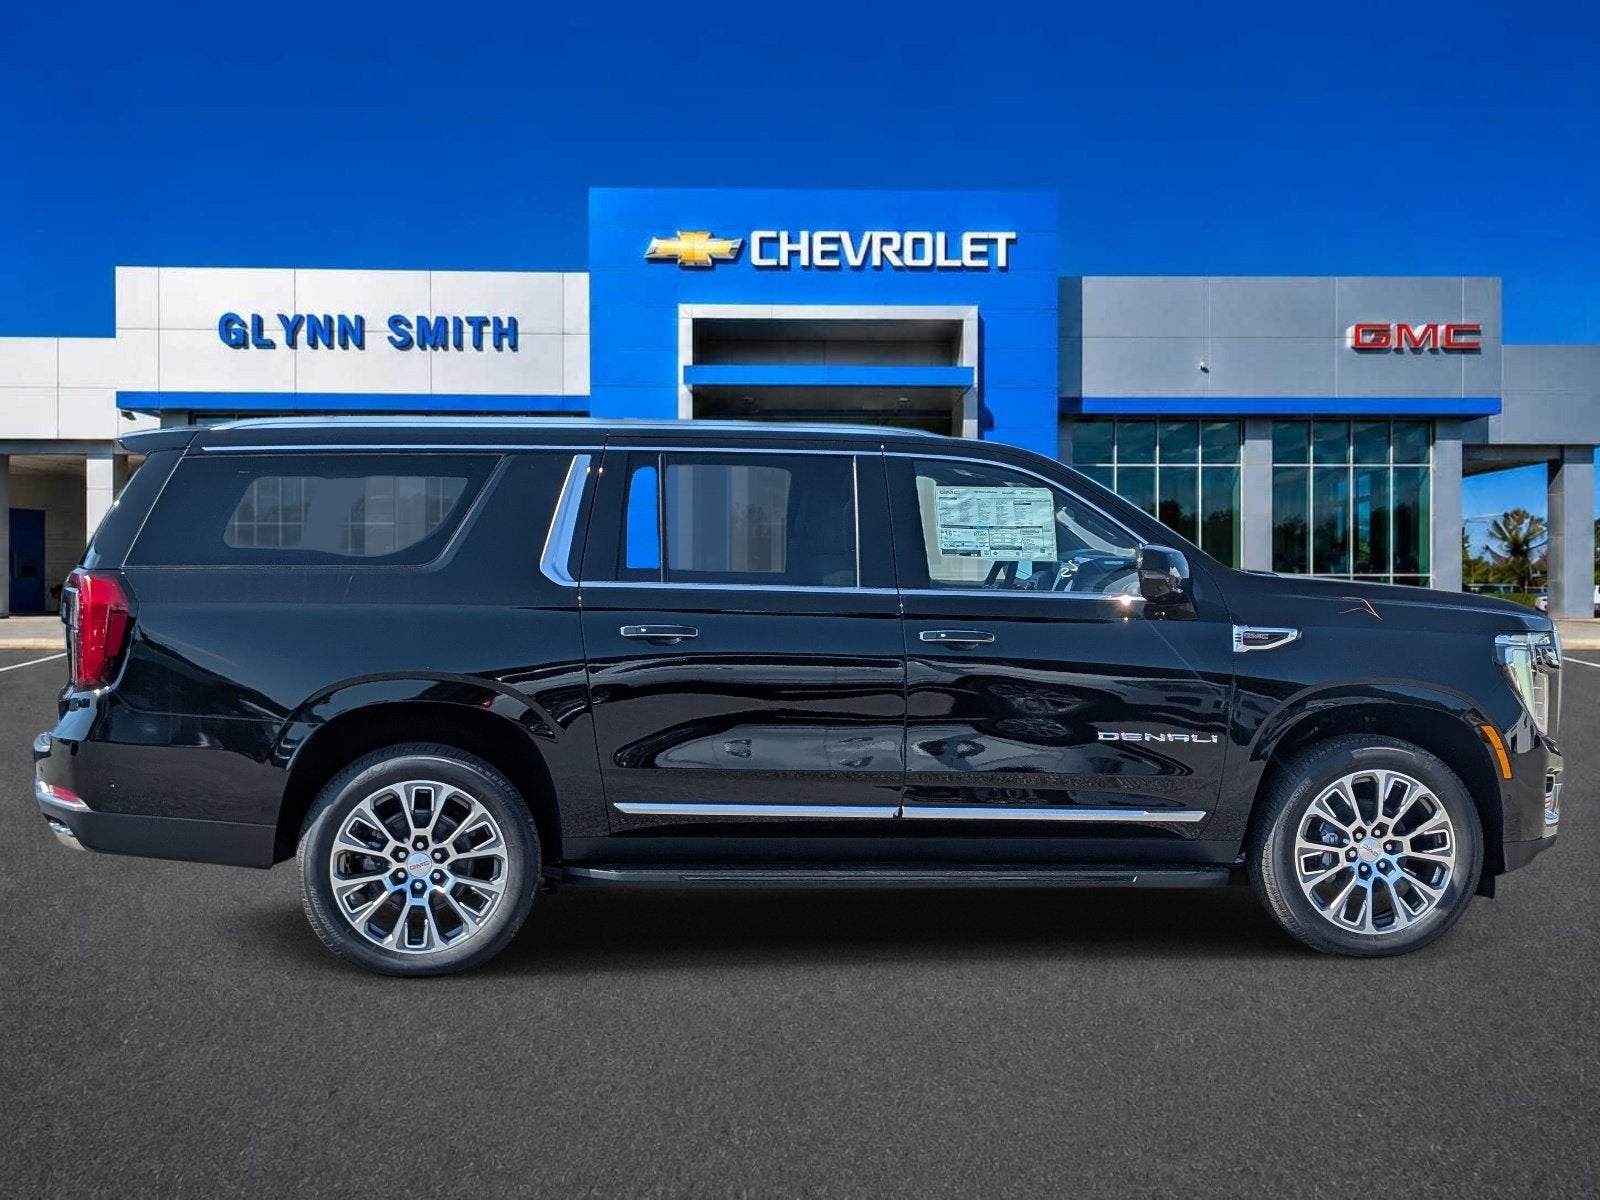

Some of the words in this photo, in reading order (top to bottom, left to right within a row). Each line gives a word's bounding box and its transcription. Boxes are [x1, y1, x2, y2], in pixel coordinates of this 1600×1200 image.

[751, 230, 1017, 268] CHEVROLET
[218, 312, 367, 350] GLYNN
[387, 314, 519, 352] SMITH
[1348, 323, 1482, 352] GMC
[1243, 632, 1269, 640] GMC
[1098, 731, 1218, 743] DENALI
[409, 860, 431, 871] GMC
